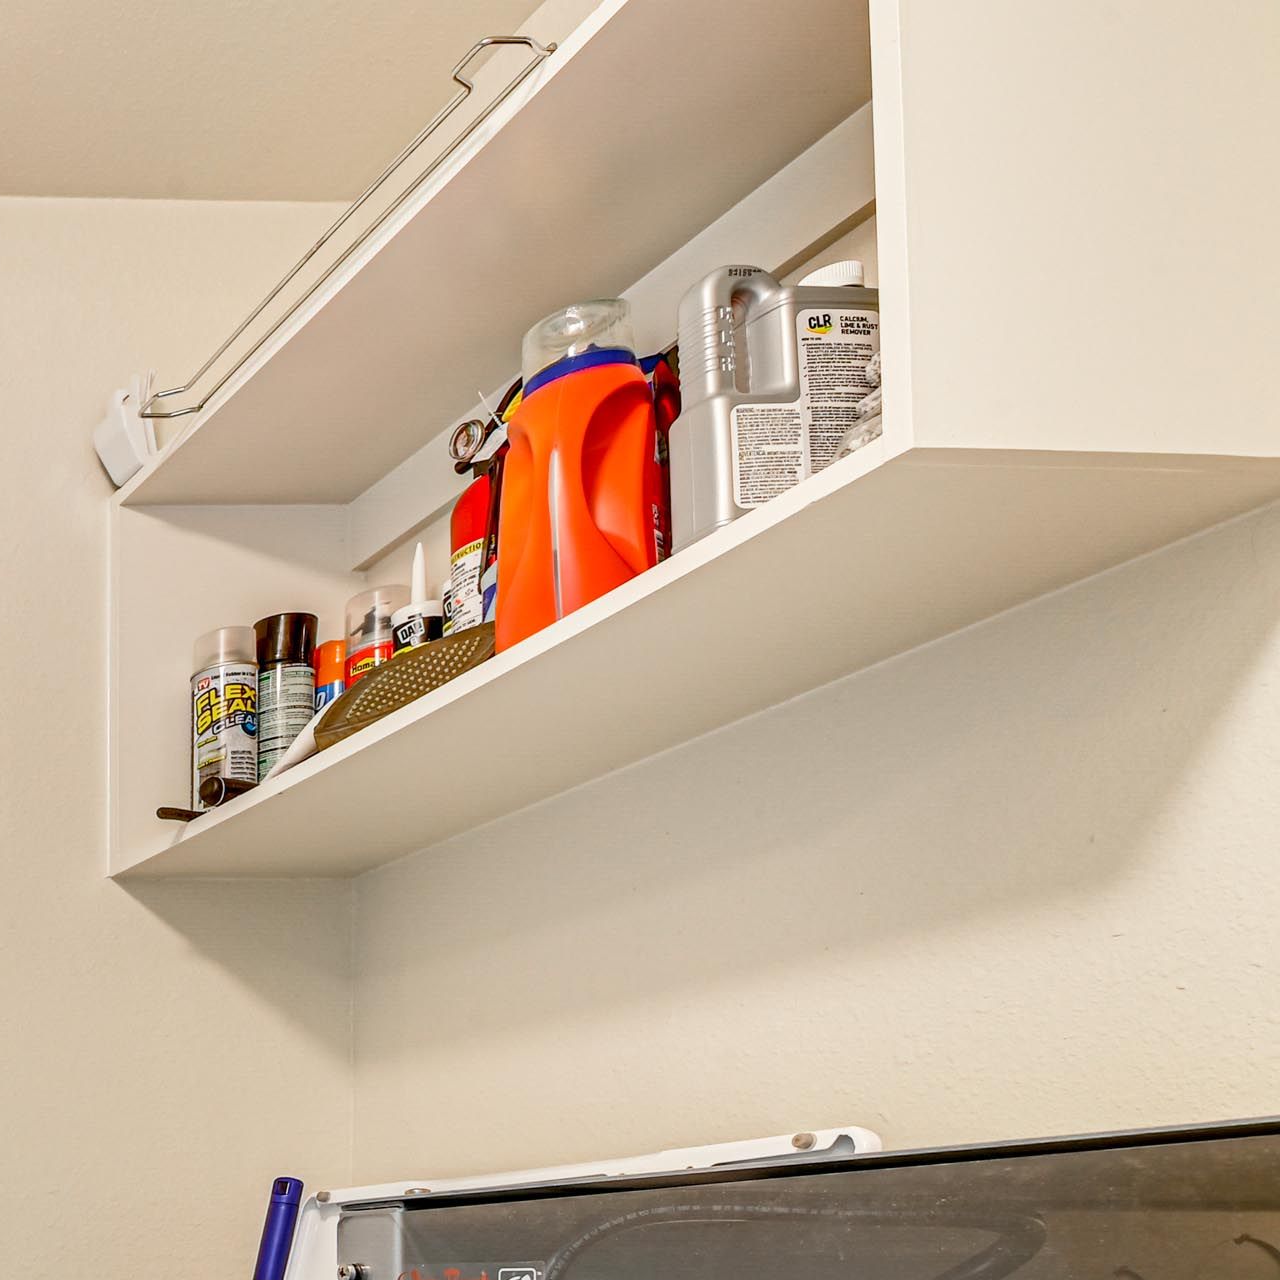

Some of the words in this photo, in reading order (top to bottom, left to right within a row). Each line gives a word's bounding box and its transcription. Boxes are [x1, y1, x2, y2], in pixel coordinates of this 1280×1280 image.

[808, 313, 832, 329] CLR
[839, 316, 869, 324] CALCIUM,
[196, 682, 256, 717] FLEX
[196, 699, 256, 735] SEAL
[212, 713, 257, 735] CLEA
